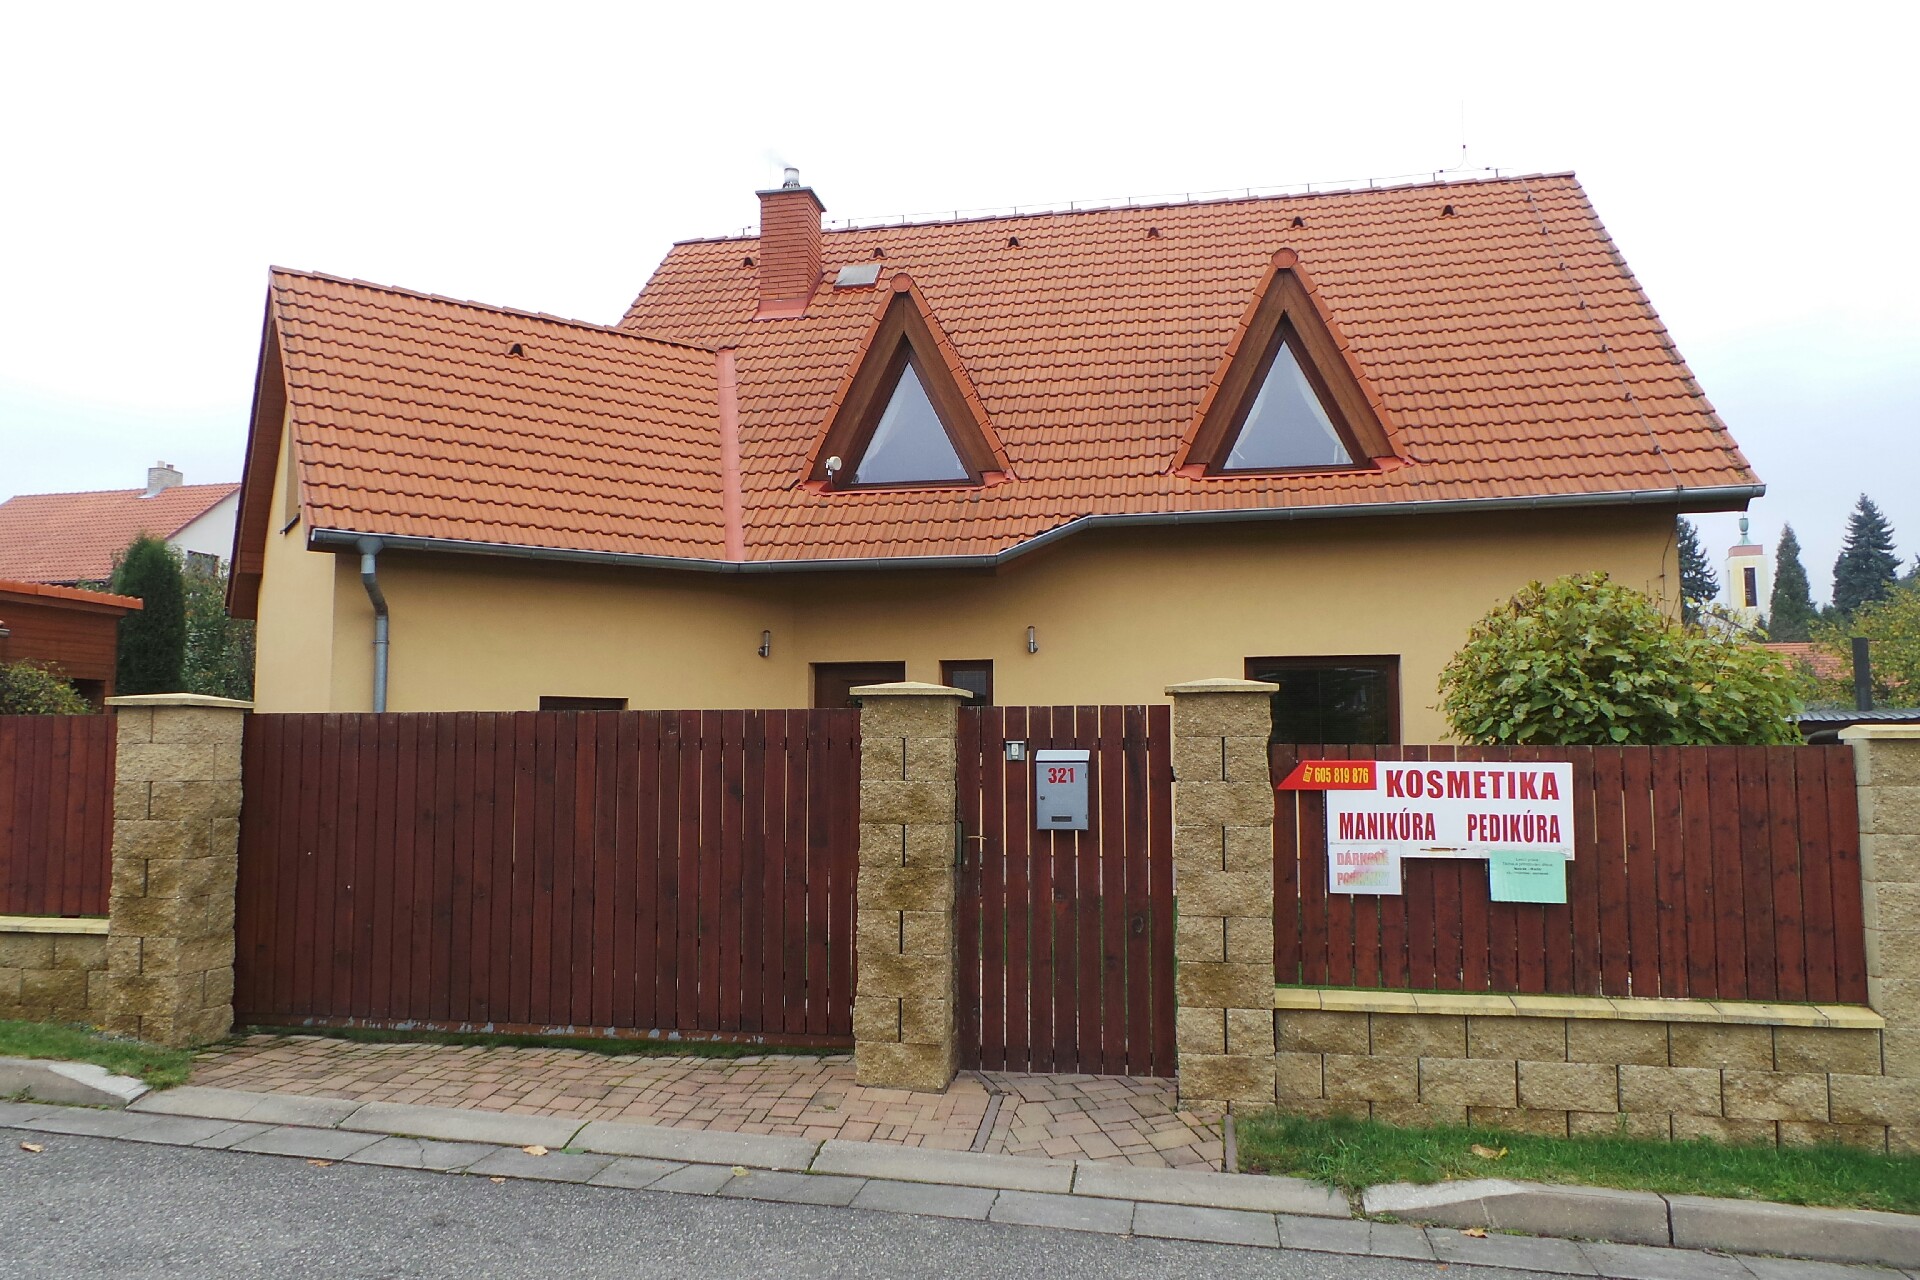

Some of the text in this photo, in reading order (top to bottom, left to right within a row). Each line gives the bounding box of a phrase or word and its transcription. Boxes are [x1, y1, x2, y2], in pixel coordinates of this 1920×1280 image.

[1047, 767, 1075, 784] 321
[1314, 767, 1369, 784] 605 819 876
[1386, 769, 1560, 801] KOSMETIKA
[1339, 807, 1561, 843] MANIKÚRA PEDIKÚRA
